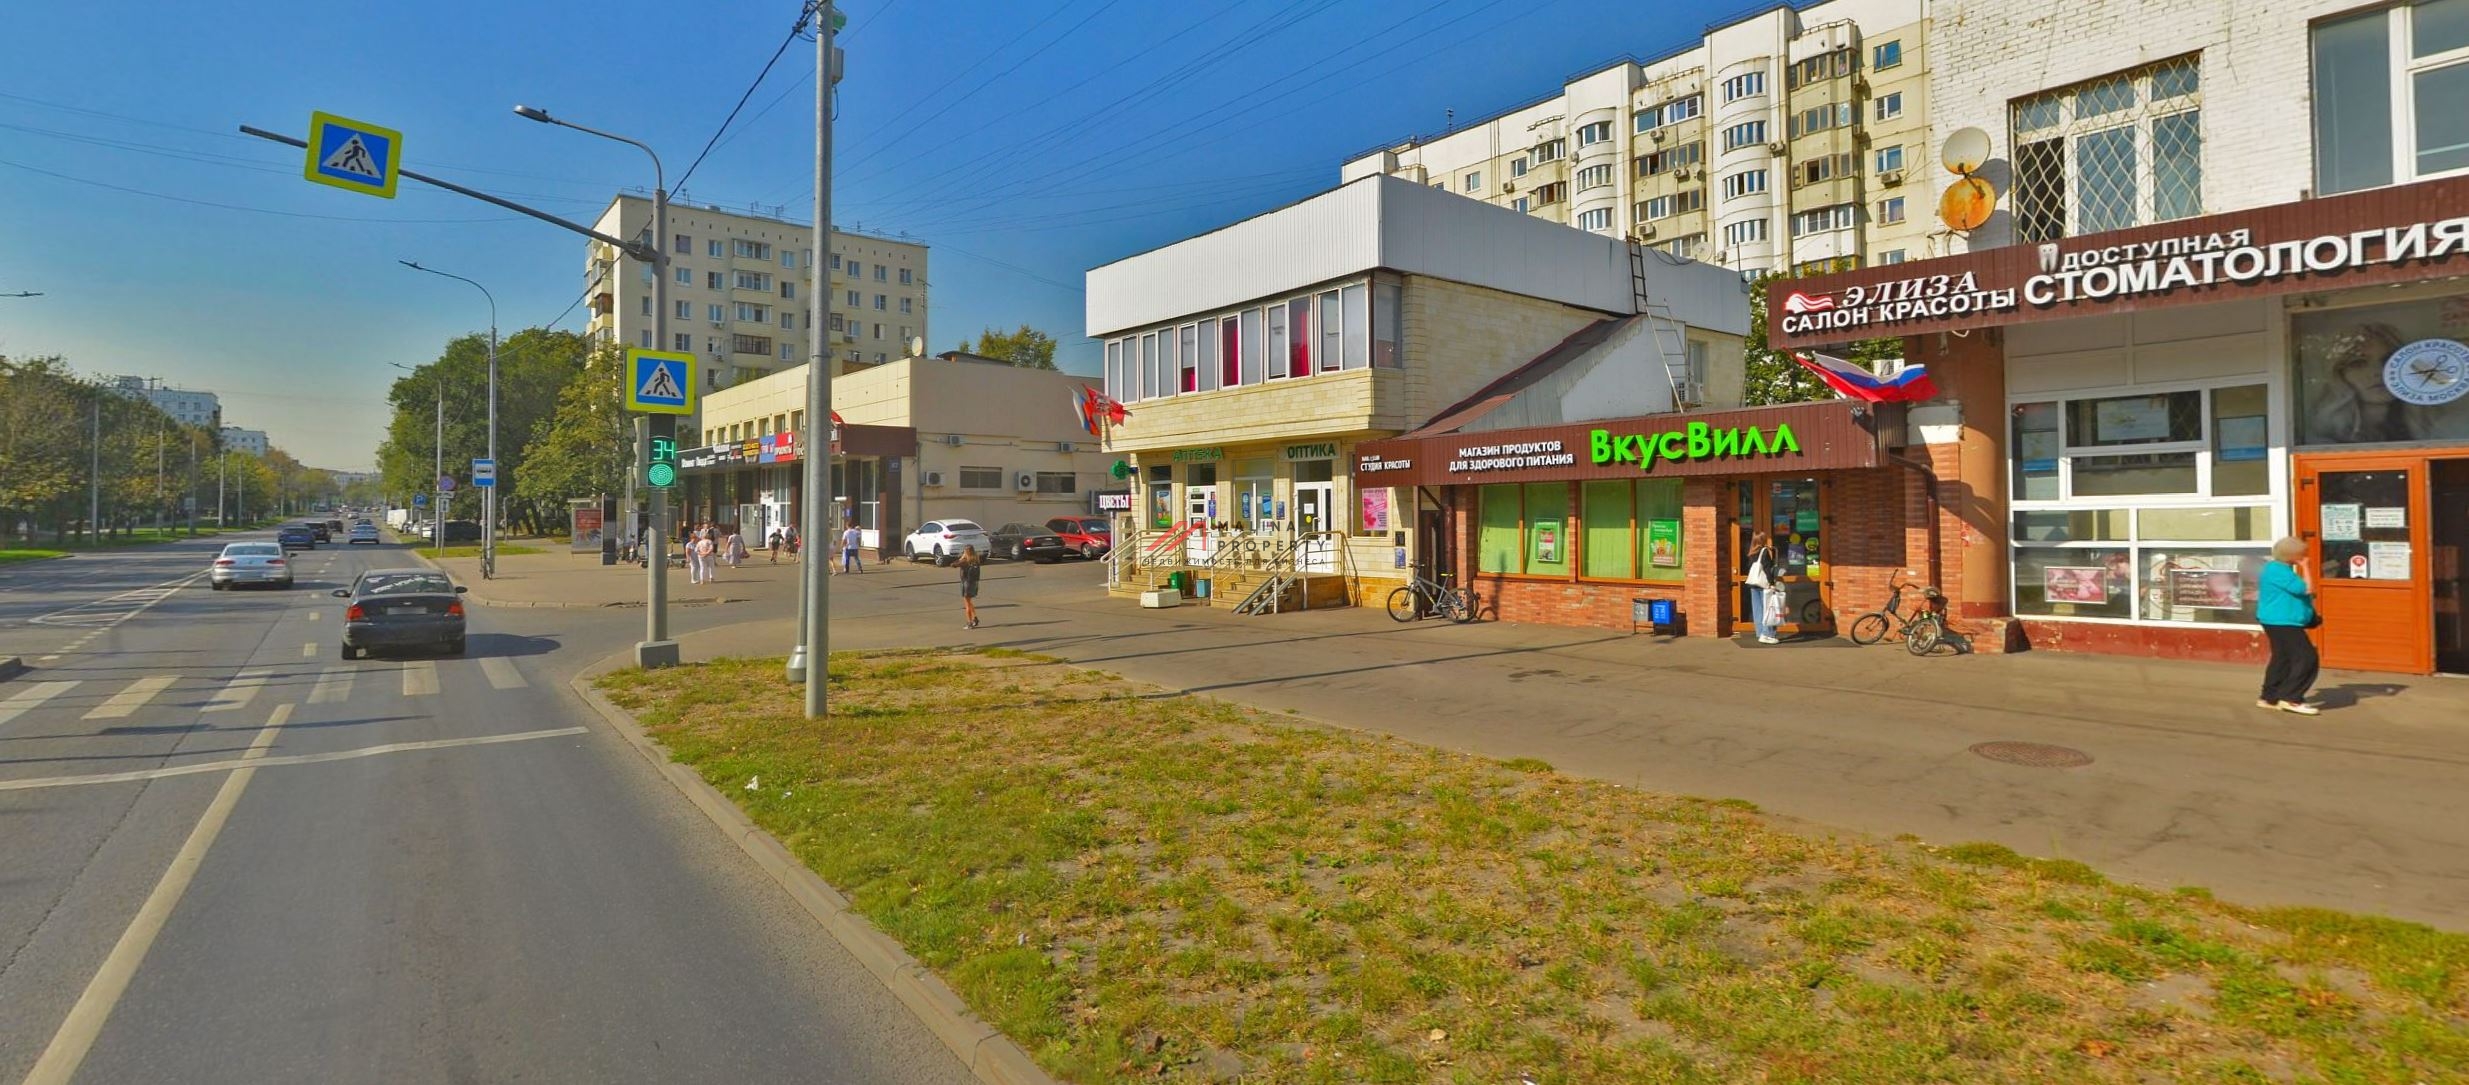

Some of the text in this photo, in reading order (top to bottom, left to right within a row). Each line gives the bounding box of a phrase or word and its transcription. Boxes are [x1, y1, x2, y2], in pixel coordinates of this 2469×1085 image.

[2061, 228, 2250, 271] ДОСТУПНАЯ
[2023, 216, 2469, 306] СТОМАТОЛОГИЯ
[1841, 270, 1978, 307] ЭЛИЗА
[1781, 288, 2015, 334] САЛОН КРАСОТЫ
[653, 440, 675, 460] 34
[1173, 447, 1223, 461] АПТЕКА
[1287, 443, 1336, 459] ОПТИКА
[1459, 440, 1562, 458] МАГАЗИН ПРОДУКТОВ
[1590, 421, 1799, 469] ВкусВилл
[1360, 459, 1411, 472] СТУДИЯ КРАСОТЫ
[1449, 452, 1573, 471] ДЛЯ ЗДОРОВОГО ПИТАНИЯ
[1099, 494, 1130, 510] ЦВЕТЫ
